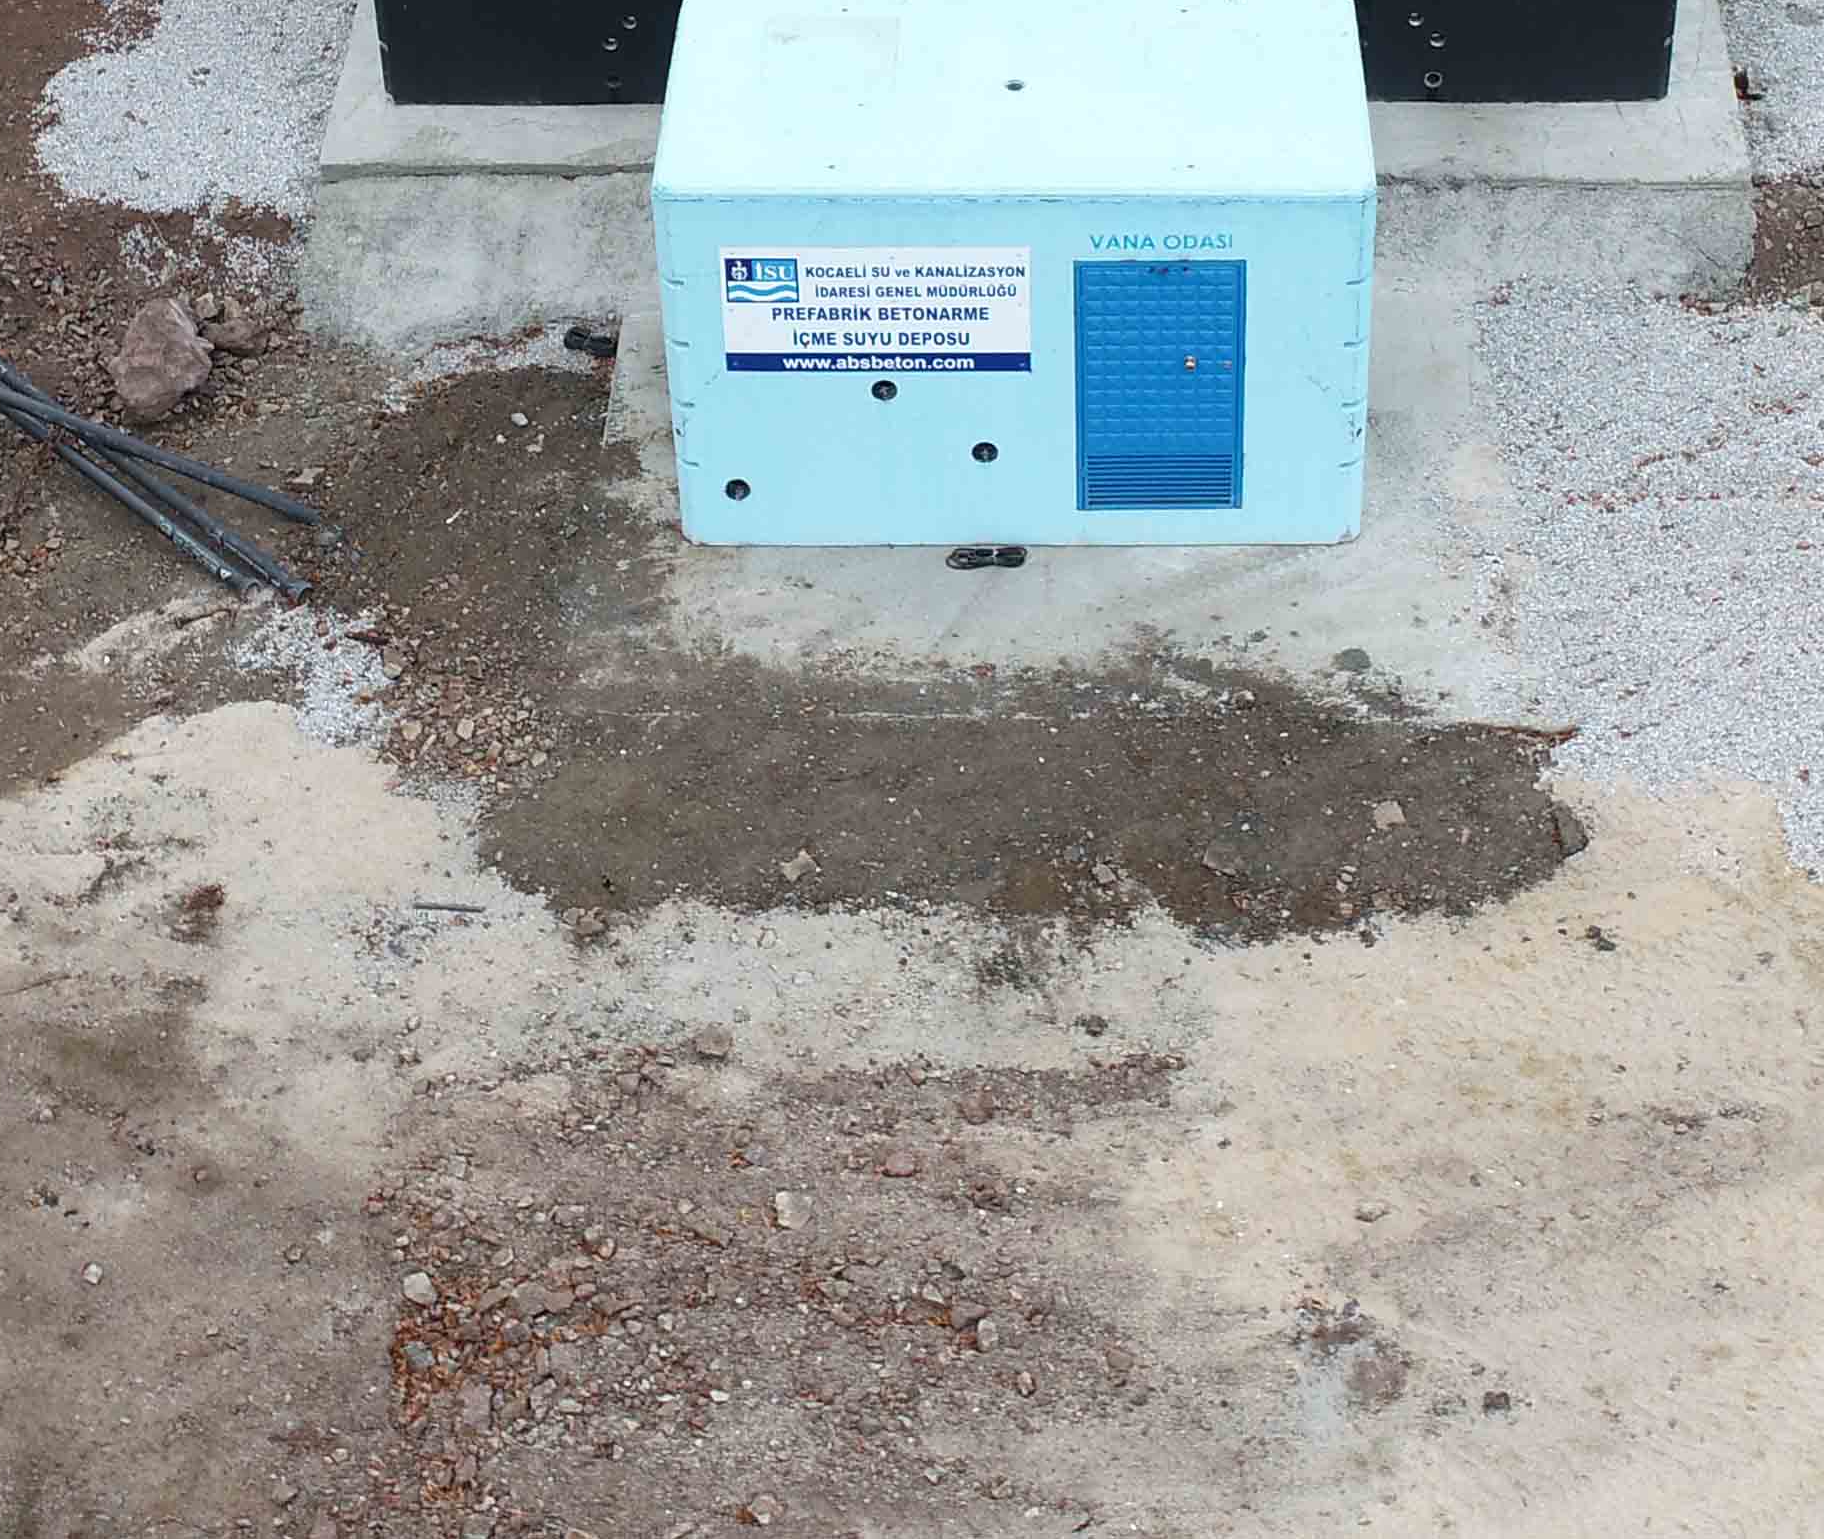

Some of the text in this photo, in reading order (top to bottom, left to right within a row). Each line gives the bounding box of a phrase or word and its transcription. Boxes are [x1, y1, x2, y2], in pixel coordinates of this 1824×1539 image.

[1090, 234, 1233, 249] VANA ODASI
[805, 263, 1025, 278] KOCAELİ SU ve KANALİZASYON
[815, 283, 1017, 298] İDARESİ GENEL MÜDÜRLÜĞÜ
[772, 303, 990, 321] PREFABRİK BETONARME
[793, 328, 970, 348] İÇME SUYU DEPOSU
[782, 355, 975, 370] www.absbeton.com
